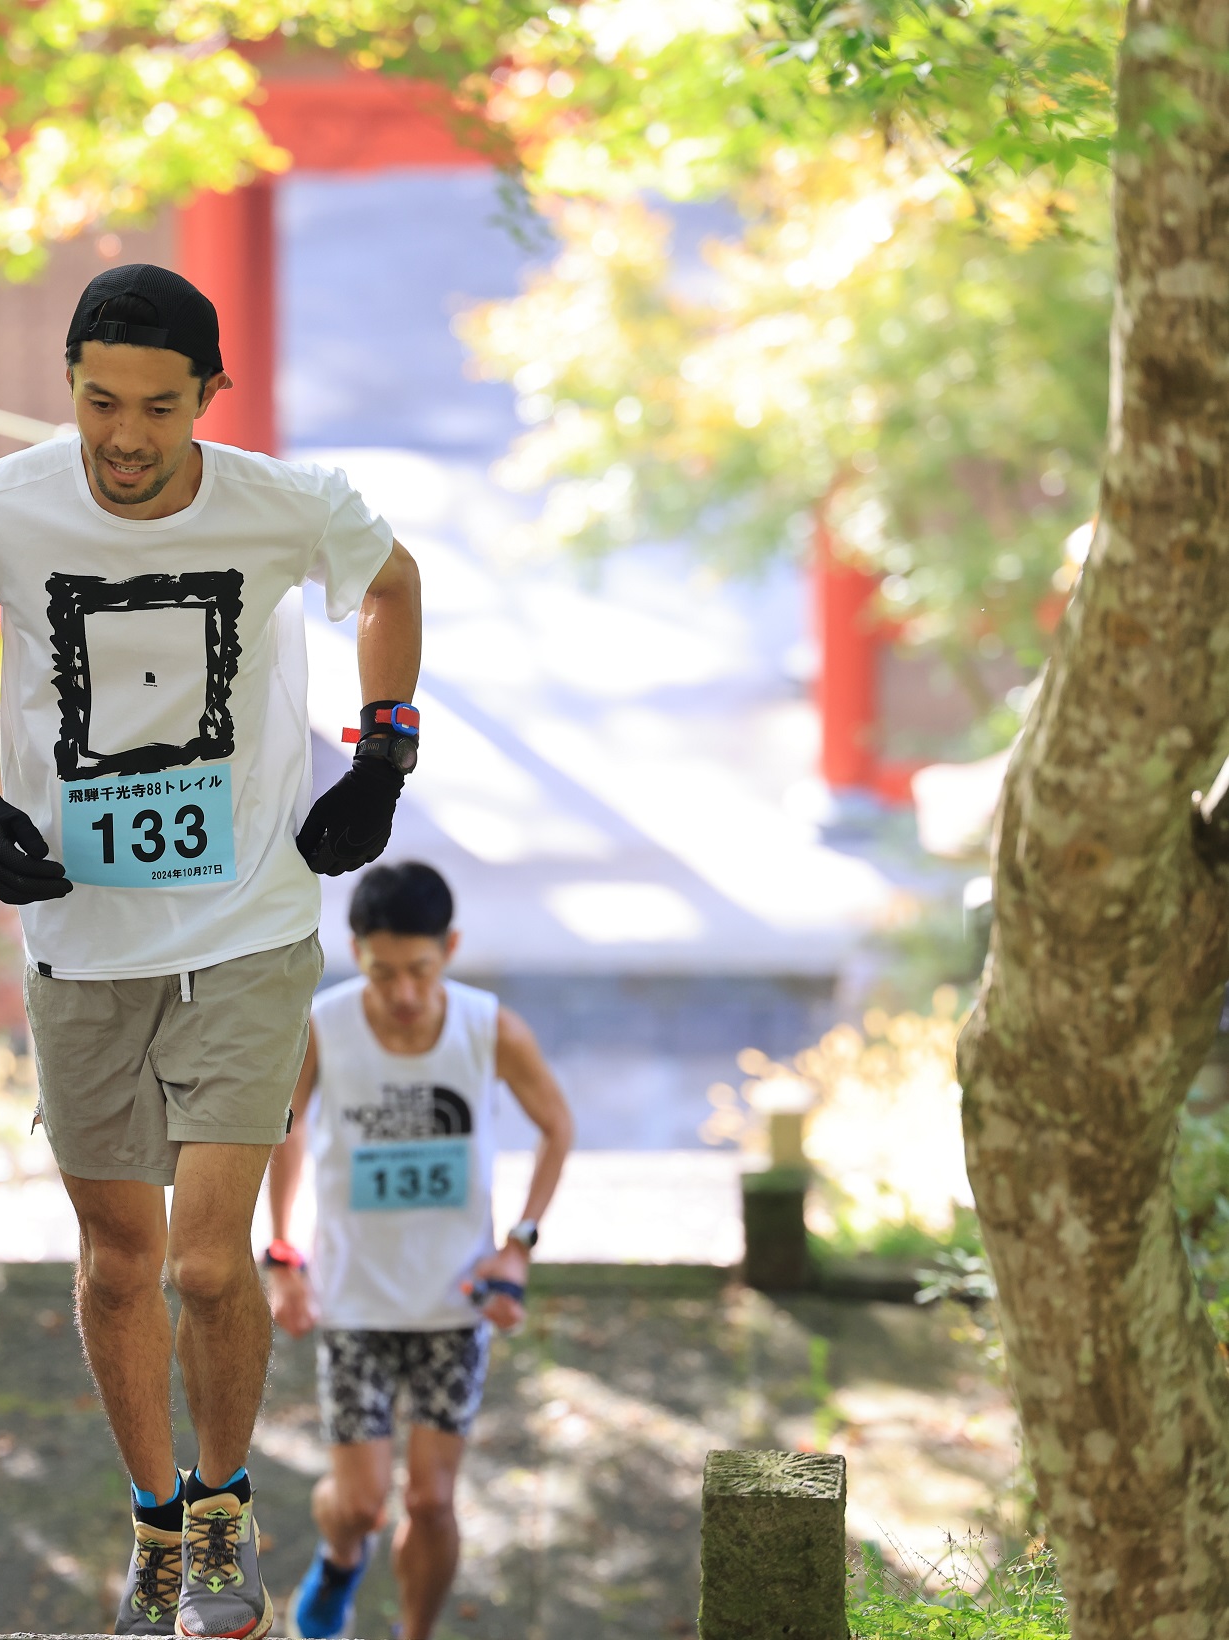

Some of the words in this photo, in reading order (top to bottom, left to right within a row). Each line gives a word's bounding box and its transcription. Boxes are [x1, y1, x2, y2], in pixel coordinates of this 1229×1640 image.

[68, 775, 223, 804] 飛騨千光寺88トレイル
[91, 804, 208, 864] 133
[151, 864, 223, 880] 2024年10月27日
[373, 1163, 452, 1200] 135
